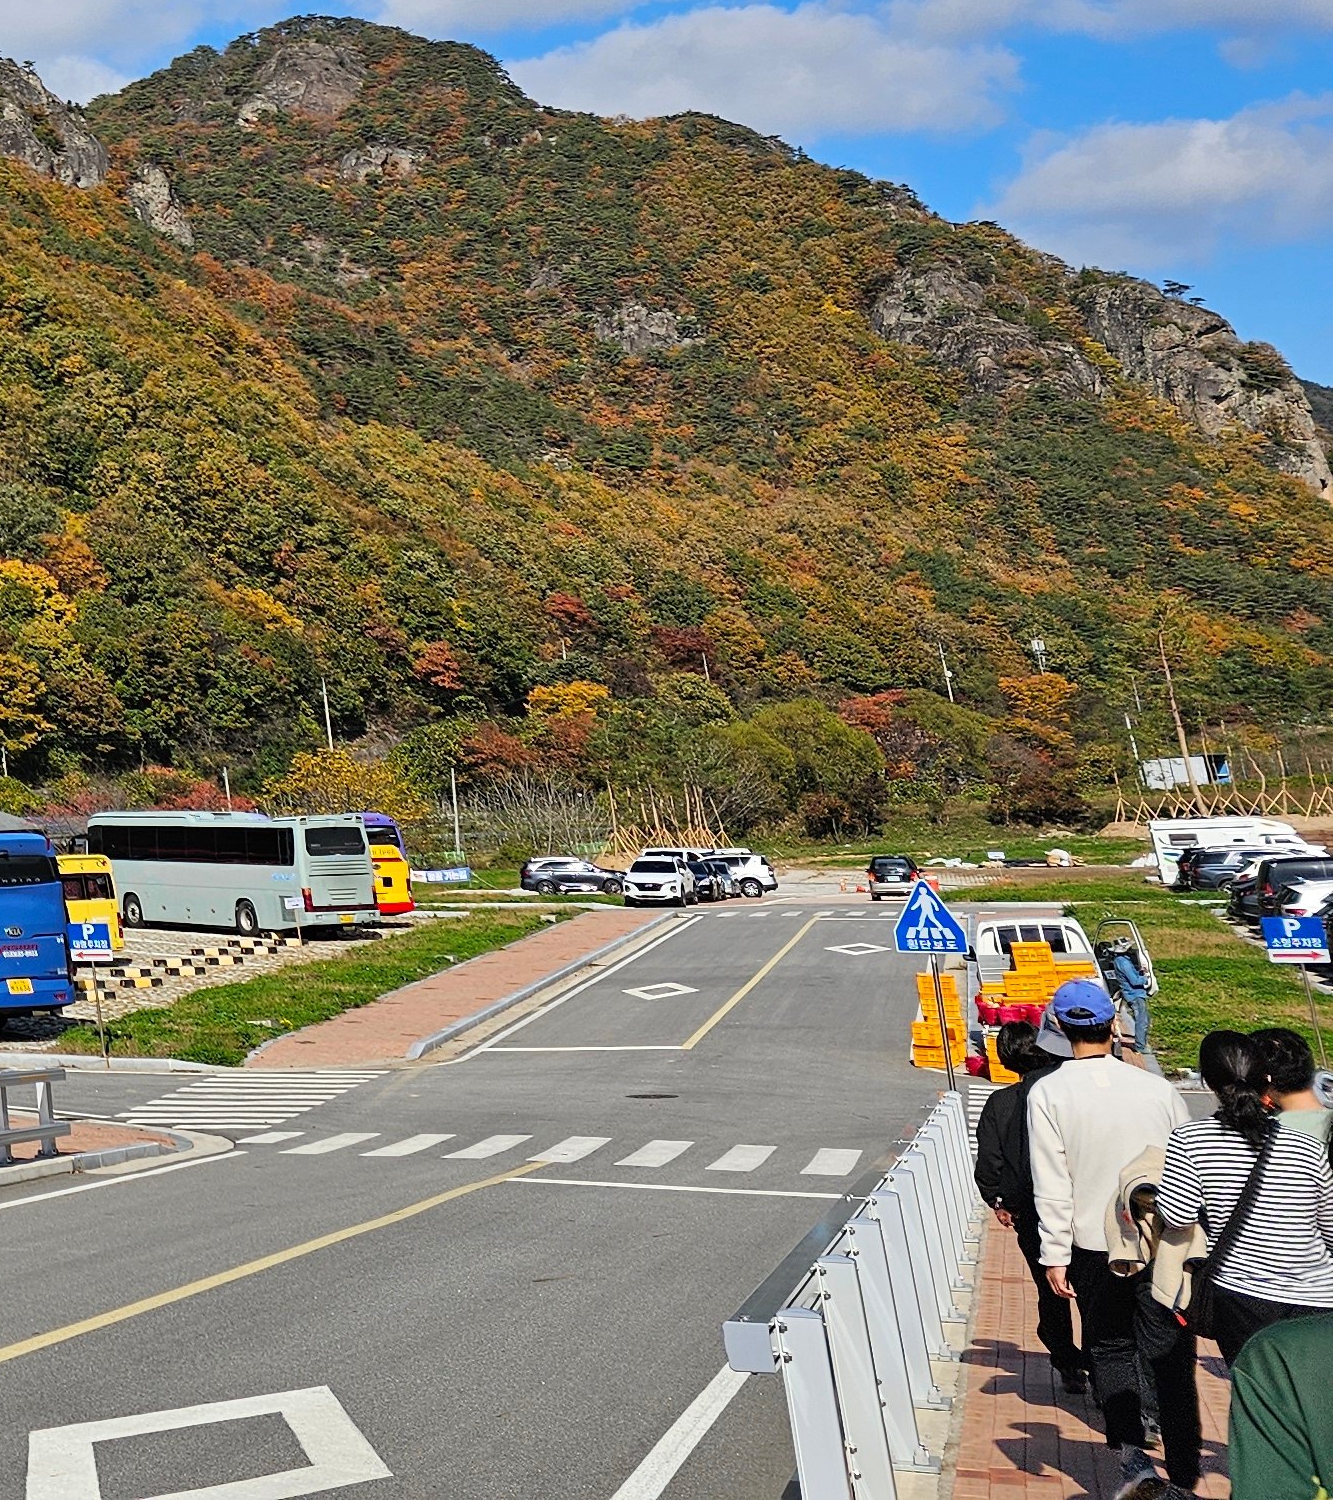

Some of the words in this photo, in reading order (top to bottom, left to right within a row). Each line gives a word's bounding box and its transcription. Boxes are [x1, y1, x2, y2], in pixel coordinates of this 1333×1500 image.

[82, 923, 95, 940] P
[1283, 918, 1301, 937] P
[906, 938, 959, 950] 횡단보도
[1271, 937, 1322, 948] 소형주차장
